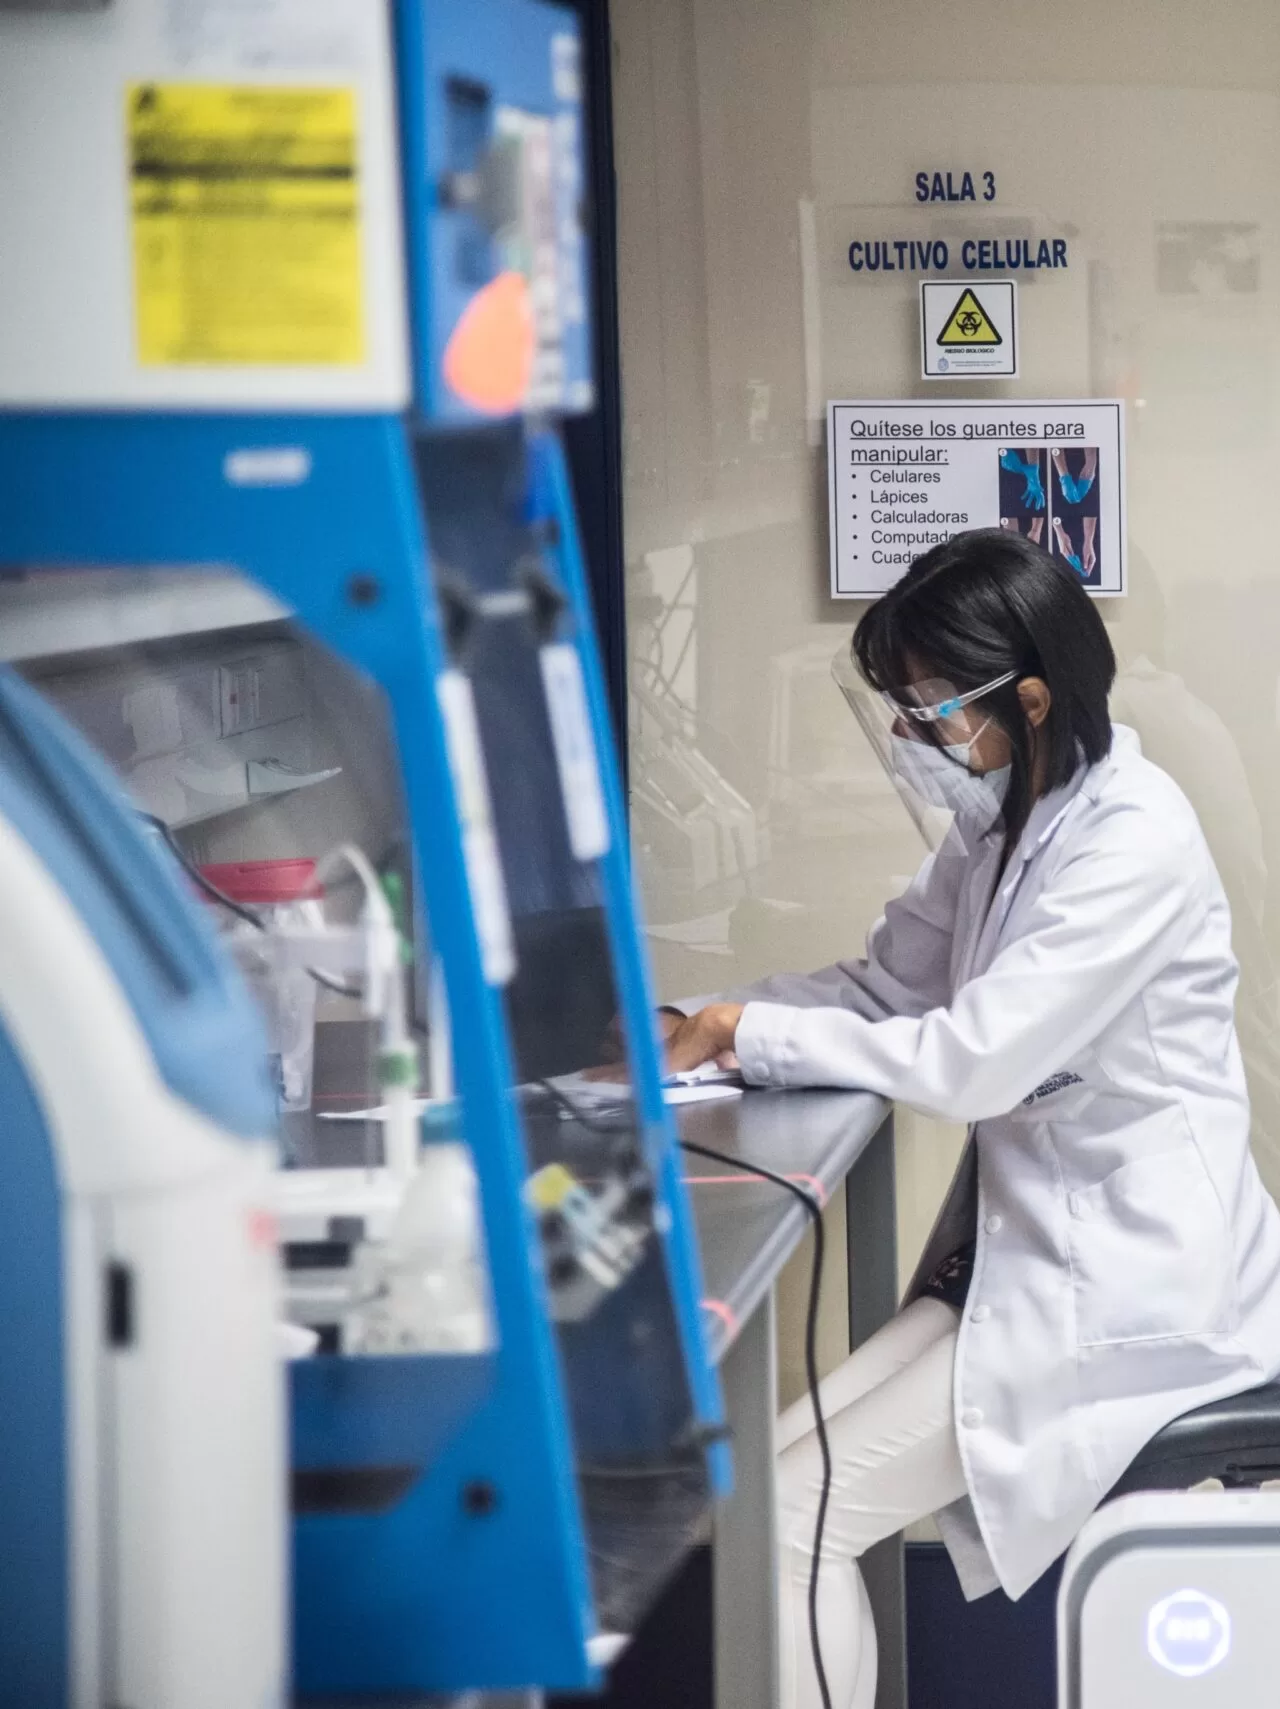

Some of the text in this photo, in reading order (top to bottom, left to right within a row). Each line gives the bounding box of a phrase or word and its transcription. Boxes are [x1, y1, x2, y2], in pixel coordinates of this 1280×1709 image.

[915, 171, 996, 201] SALA 3
[849, 239, 1068, 271] CULTIVO CELULAR
[850, 419, 1085, 440] Quítese los guantes para
[851, 445, 948, 465] manipular:
[870, 469, 941, 483] Celulares
[870, 489, 928, 506] Lápices
[870, 510, 969, 523] Calculadoras
